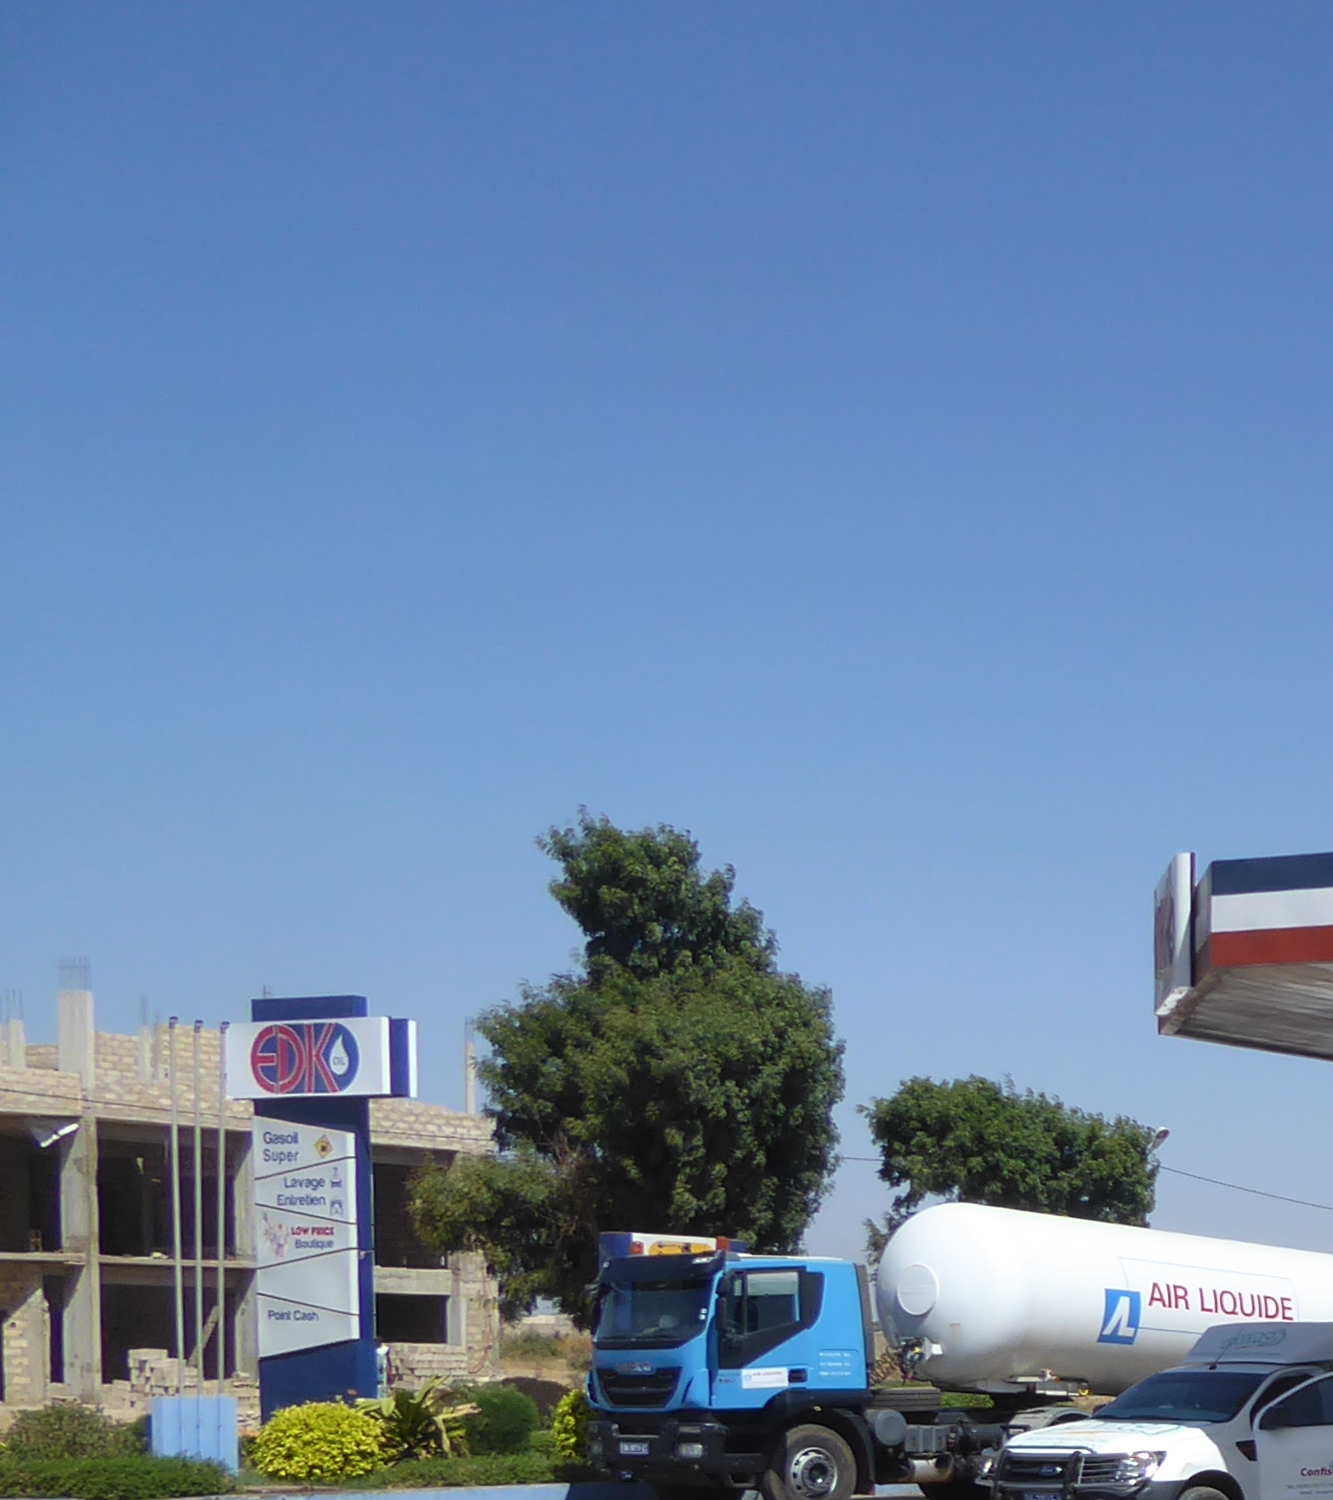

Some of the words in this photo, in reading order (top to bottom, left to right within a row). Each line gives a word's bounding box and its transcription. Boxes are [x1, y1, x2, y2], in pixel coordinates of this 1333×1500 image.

[263, 1148, 299, 1165] Super
[284, 1177, 326, 1191] Lavage
[277, 1194, 327, 1206] Entretien
[295, 1239, 334, 1250] Boutique
[1148, 1282, 1190, 1310] AIR
[1198, 1287, 1294, 1321] LIQUIDE
[268, 1309, 291, 1321] Point
[293, 1309, 319, 1321] Cash
